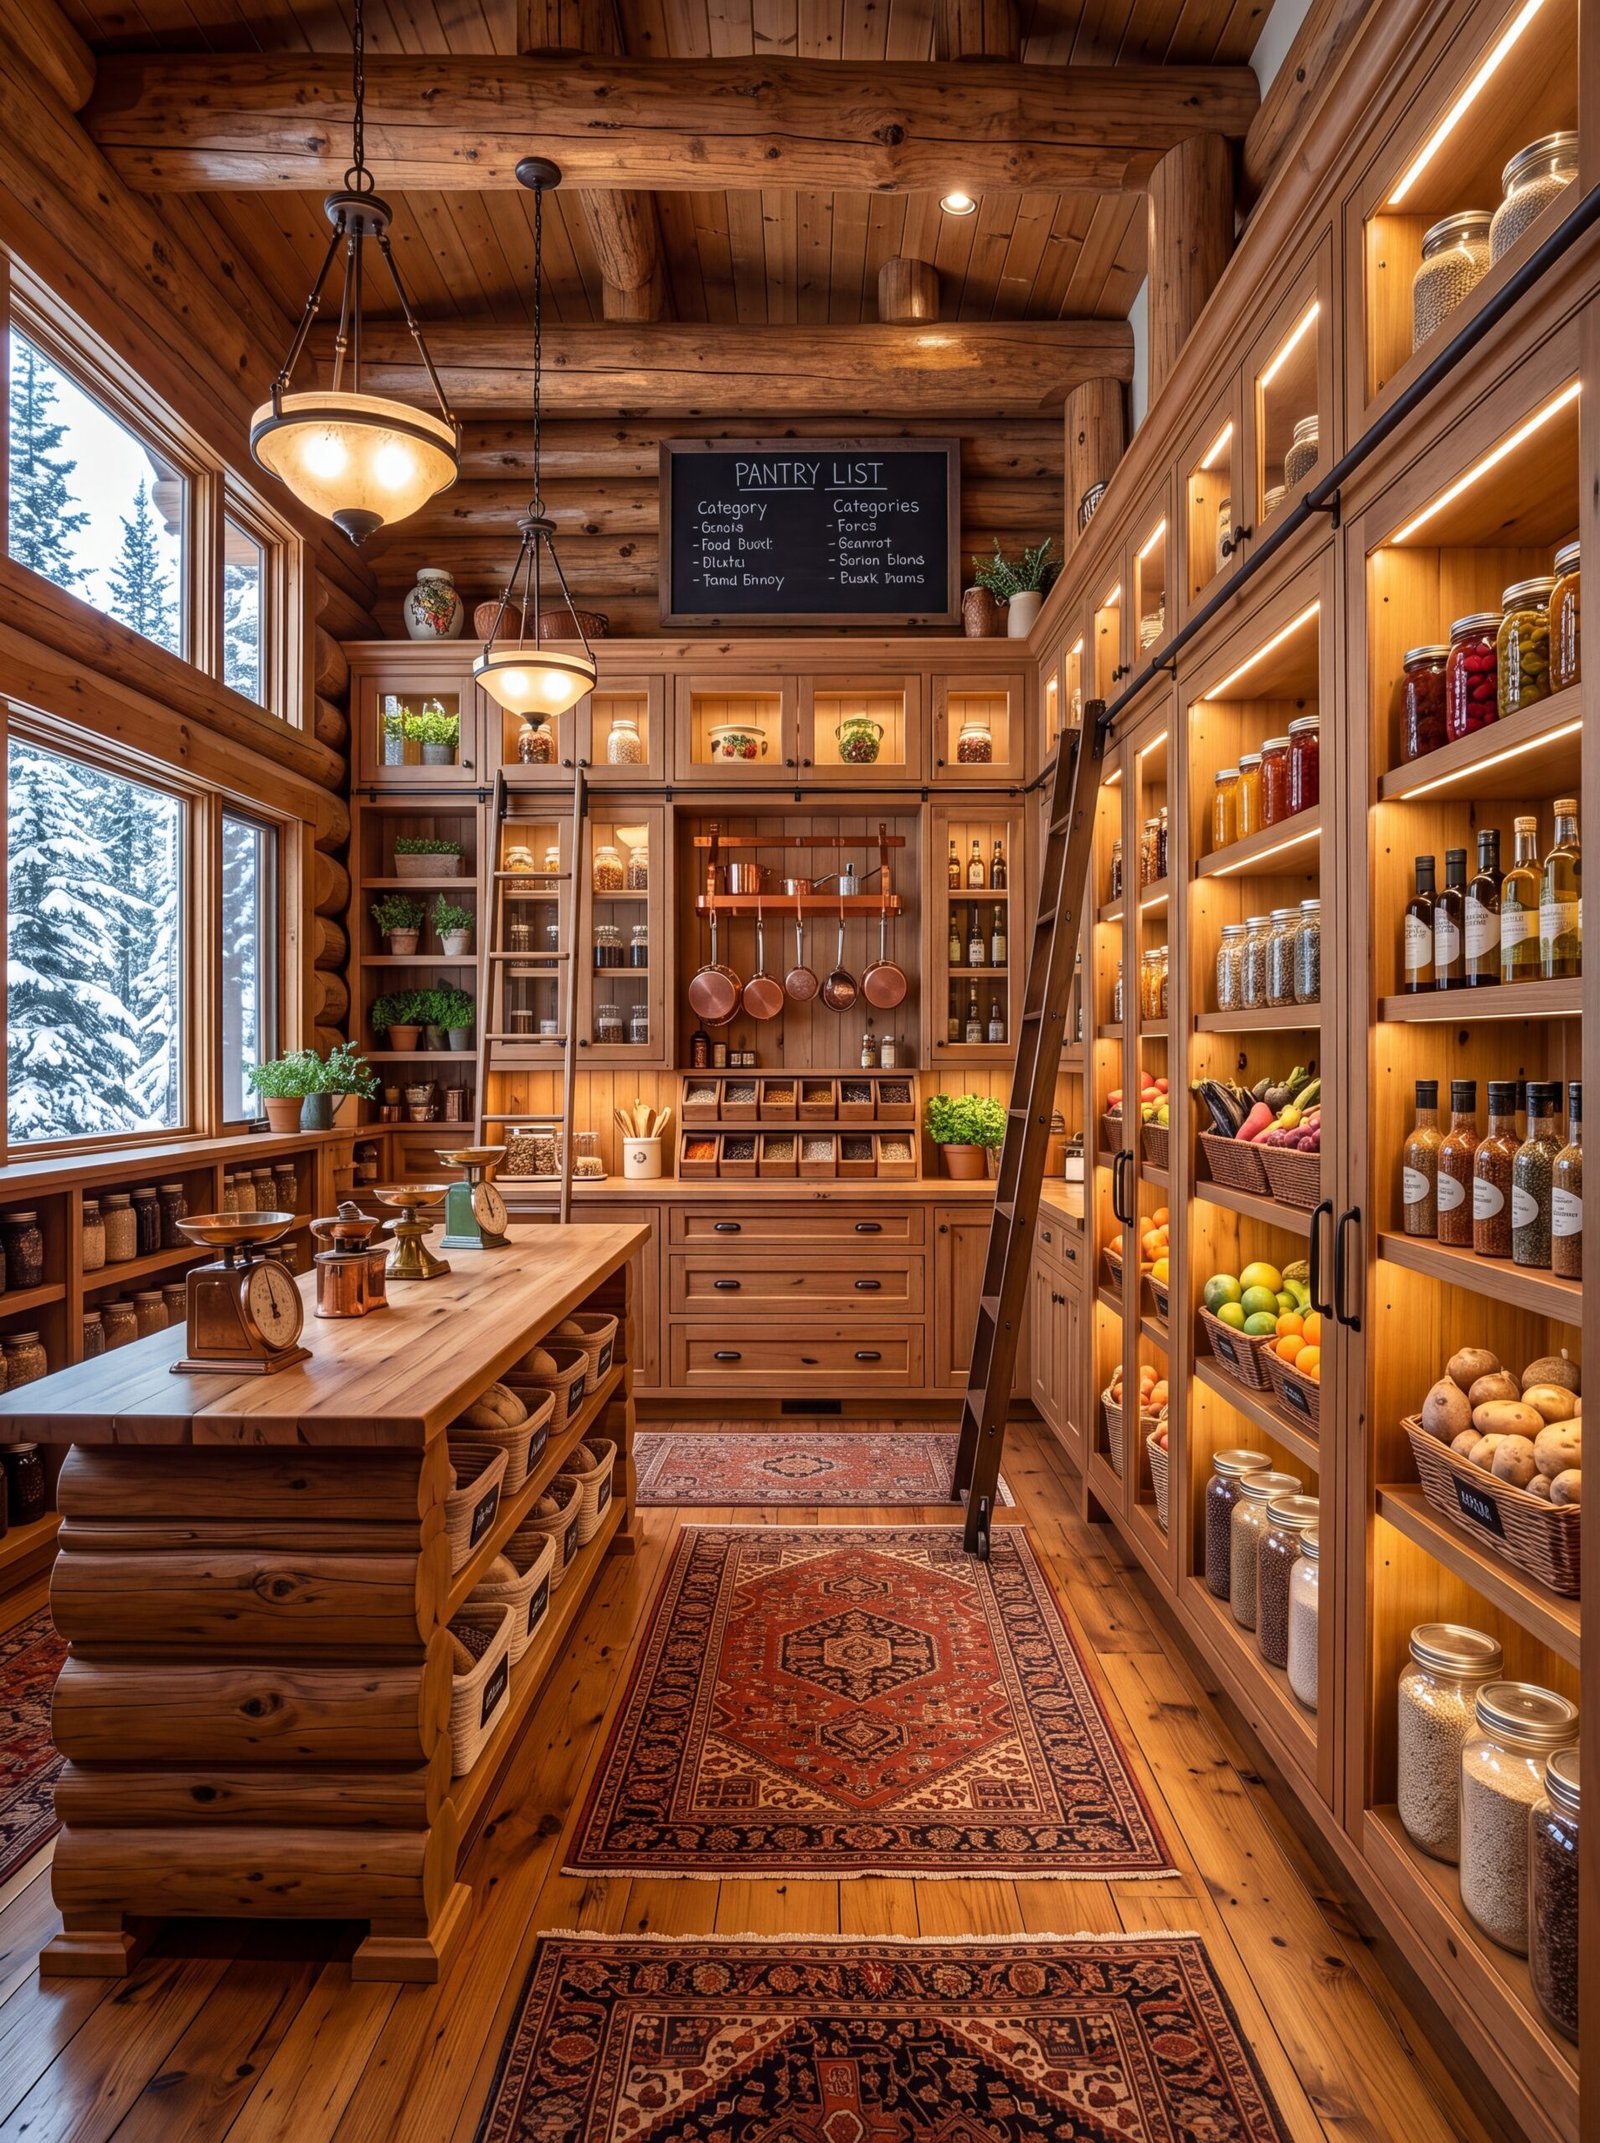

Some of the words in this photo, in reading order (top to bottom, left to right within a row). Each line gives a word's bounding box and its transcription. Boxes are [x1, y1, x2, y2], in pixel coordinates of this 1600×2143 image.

[735, 462, 820, 486] PANTRY
[833, 462, 884, 484] LIST
[697, 500, 768, 521] Category
[833, 499, 920, 519] Categories
[702, 538, 731, 551] Food
